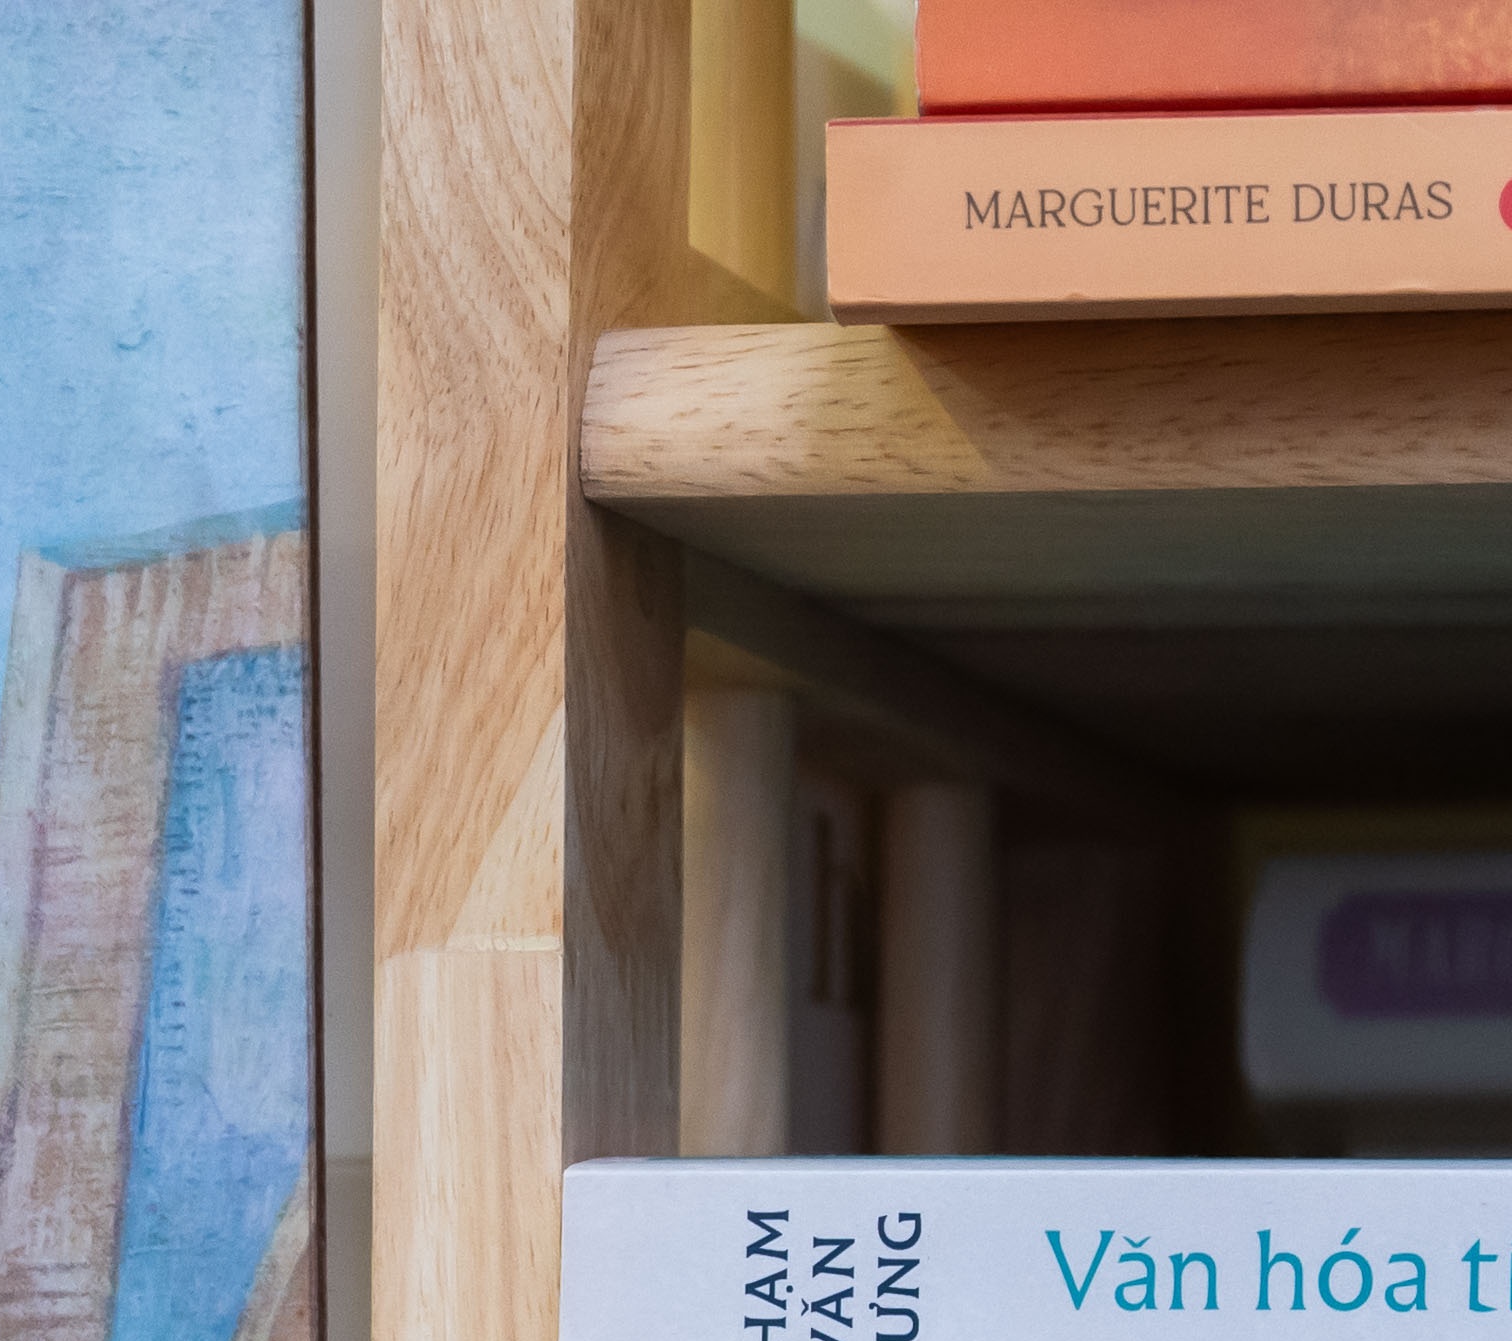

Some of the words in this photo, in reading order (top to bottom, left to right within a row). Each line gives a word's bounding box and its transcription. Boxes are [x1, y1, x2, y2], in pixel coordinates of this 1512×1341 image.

[962, 184, 1269, 232] MARGUERITE
[1291, 180, 1454, 224] DURAS
[1044, 1229, 1220, 1315] Văn
[1254, 1226, 1430, 1315] hóa
